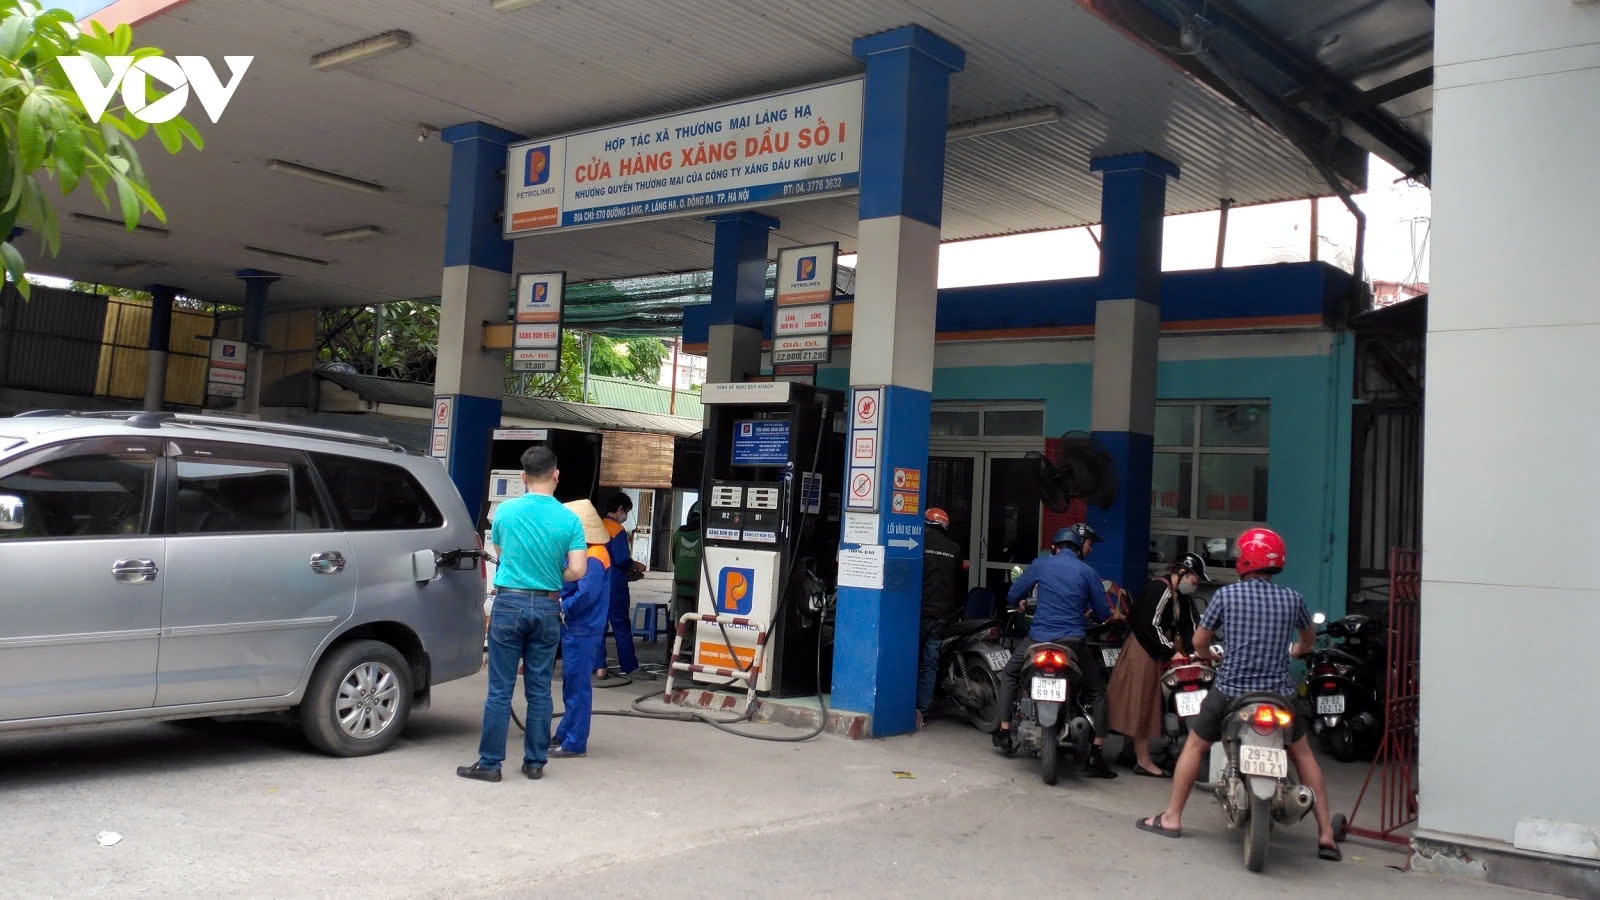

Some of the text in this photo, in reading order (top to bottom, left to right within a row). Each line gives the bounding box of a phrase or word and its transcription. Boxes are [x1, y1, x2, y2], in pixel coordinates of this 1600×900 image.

[604, 104, 812, 152] HỢP TÁC XÃ THƯƠNG MẠI LÁNG HẠ
[575, 156, 612, 184] CỬA
[619, 151, 673, 177] HÀNG
[680, 140, 737, 167] XĂNG
[744, 126, 790, 157] DẦU
[797, 116, 830, 149] SỐ
[574, 187, 605, 199] NHƯỢNG
[635, 177, 667, 191] THƯƠNG
[686, 171, 703, 183] CỦA
[730, 167, 741, 177] TY
[793, 156, 813, 168] KHU
[817, 151, 837, 165] VỰC
[516, 186, 556, 199] PETROLIMEX
[596, 210, 605, 220] 570
[728, 189, 737, 202] HÀ
[738, 188, 750, 201] NỘI
[807, 179, 824, 192] 3776
[825, 177, 842, 189] 3632
[525, 362, 546, 370] 22.000
[1036, 689, 1061, 698] 6919
[1247, 749, 1280, 762] 29-Z1
